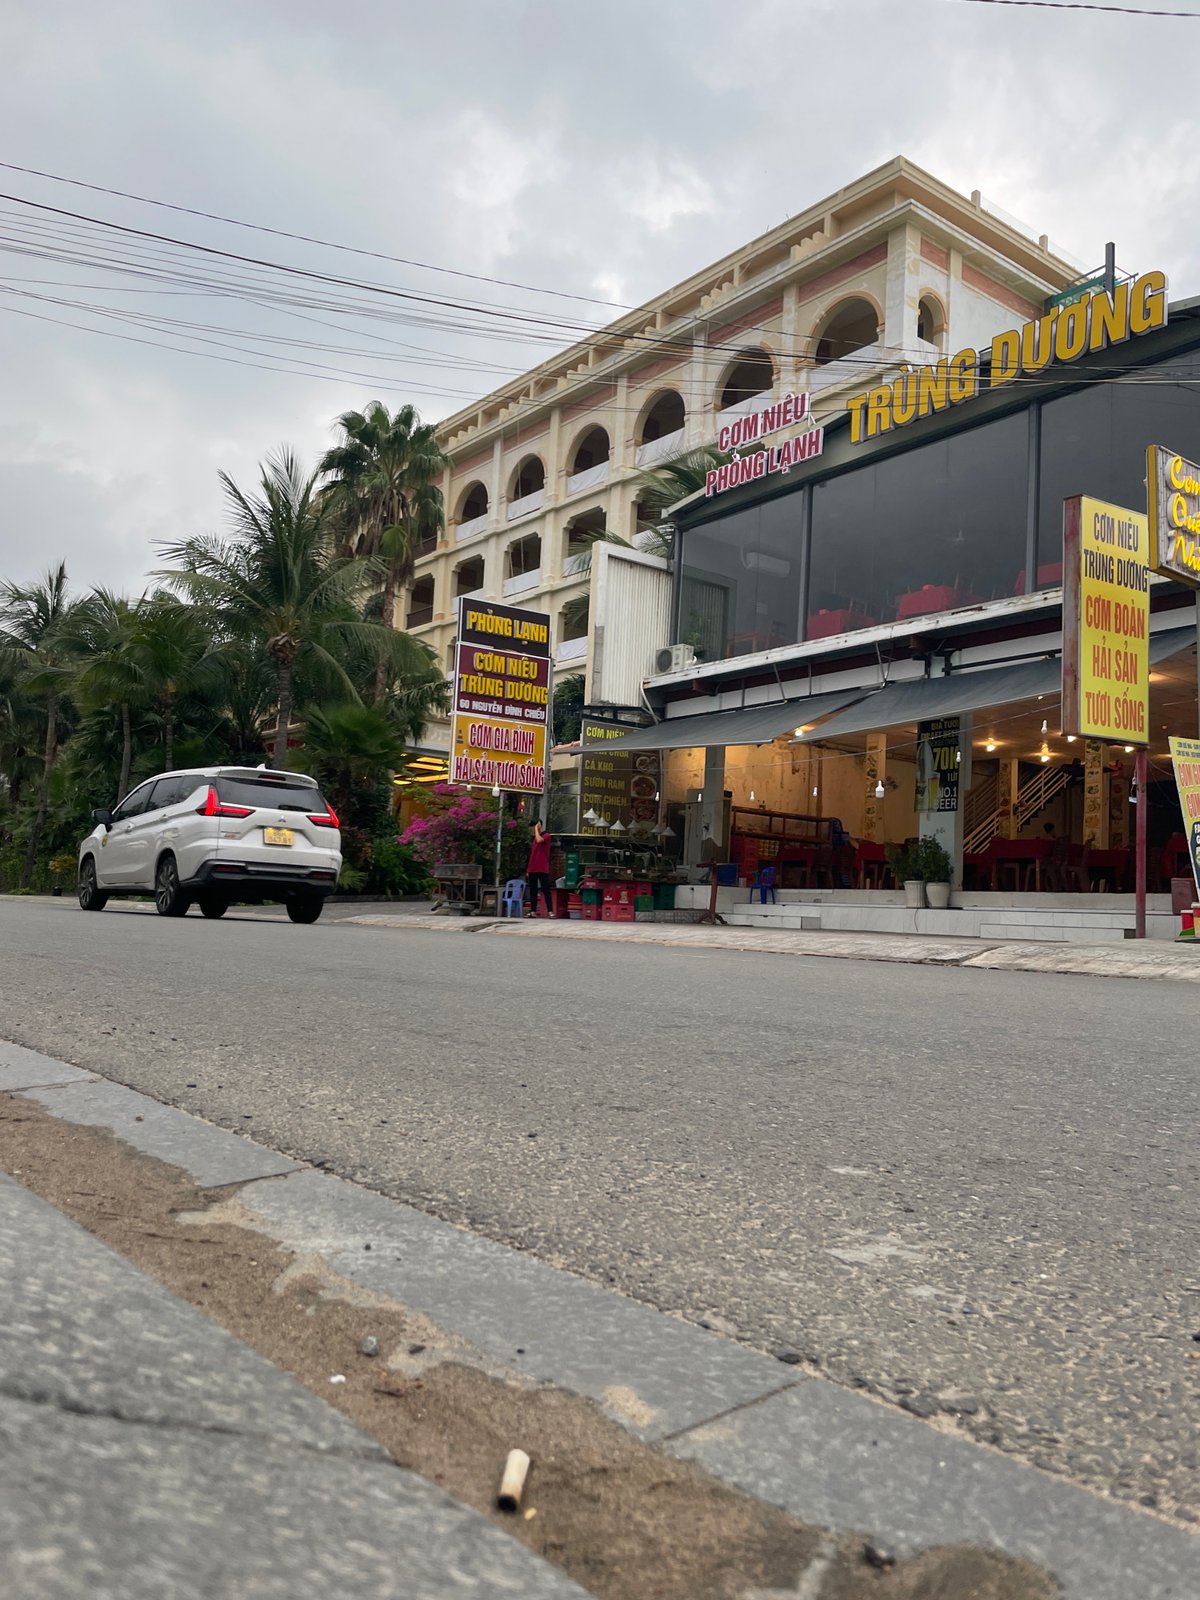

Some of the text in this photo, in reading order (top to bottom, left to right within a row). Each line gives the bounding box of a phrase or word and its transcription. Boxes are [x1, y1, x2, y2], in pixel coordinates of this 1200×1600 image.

[847, 271, 1168, 443] TRÙNG DƯƠNG
[719, 392, 809, 452] CƠM NIÊU
[706, 427, 823, 497] PHÒNG LẠNH
[1094, 512, 1139, 552] CƠM NIÊU
[1084, 546, 1148, 593] TRÙNG DƯƠNG
[466, 608, 547, 645] PHÒNG LẠNH
[1086, 594, 1145, 640] CƠM ĐOÀN
[474, 652, 538, 679] CƠM NIÊU
[1093, 635, 1138, 685] HẢI SẢN
[460, 673, 548, 705] TRÙNG DƯƠNG
[1086, 687, 1145, 733] TƯƠI SỐNG
[469, 722, 493, 749] CƠM
[494, 726, 510, 751] GIA
[512, 725, 535, 755] ĐÌNH
[586, 726, 605, 738] CƠM
[455, 749, 545, 789] HẢI SẢN TƯƠI SỐNG
[597, 761, 614, 772] KHO
[933, 746, 959, 770] 70K
